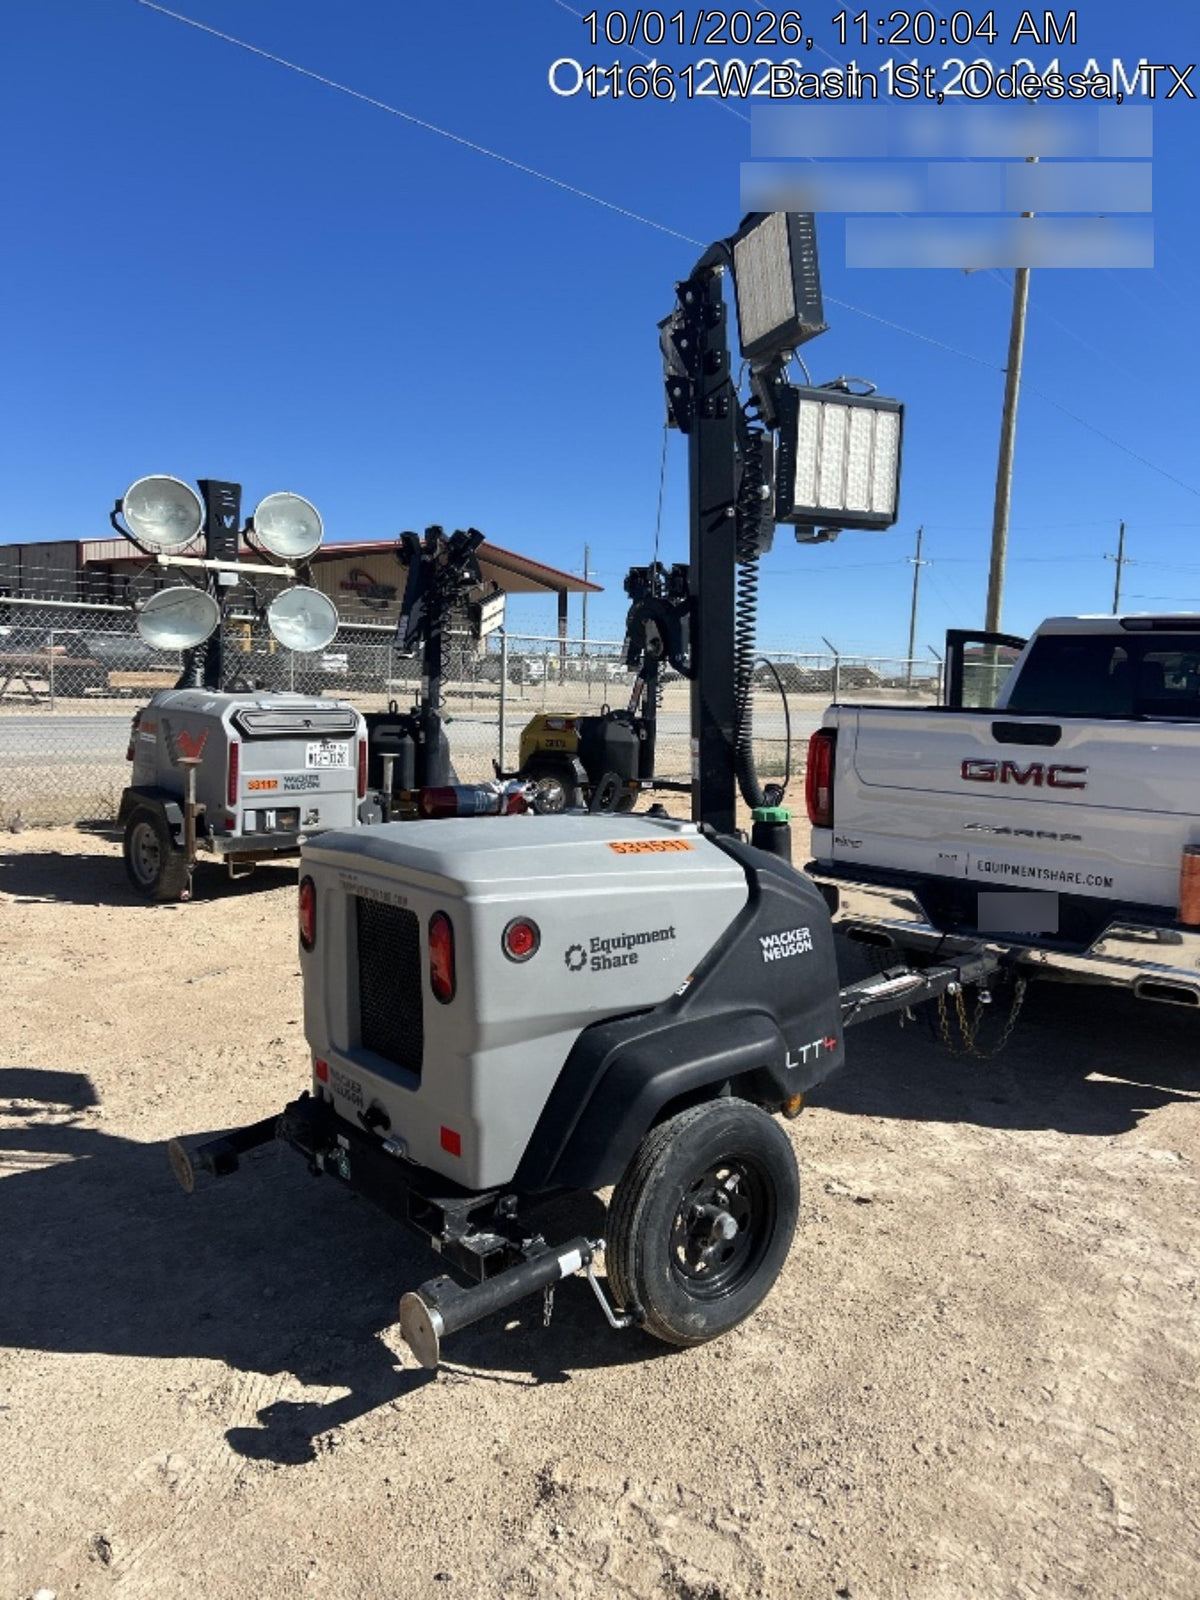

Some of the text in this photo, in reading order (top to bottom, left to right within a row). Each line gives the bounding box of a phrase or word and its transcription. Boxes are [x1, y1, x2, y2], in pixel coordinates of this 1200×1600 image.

[960, 758, 1089, 790] GMC
[976, 860, 1115, 888] EQUIPMENTSHARE.COM
[589, 926, 676, 953] Equipment
[759, 927, 811, 949] WACKER
[762, 939, 813, 962] NEUSON
[590, 952, 638, 972] Share
